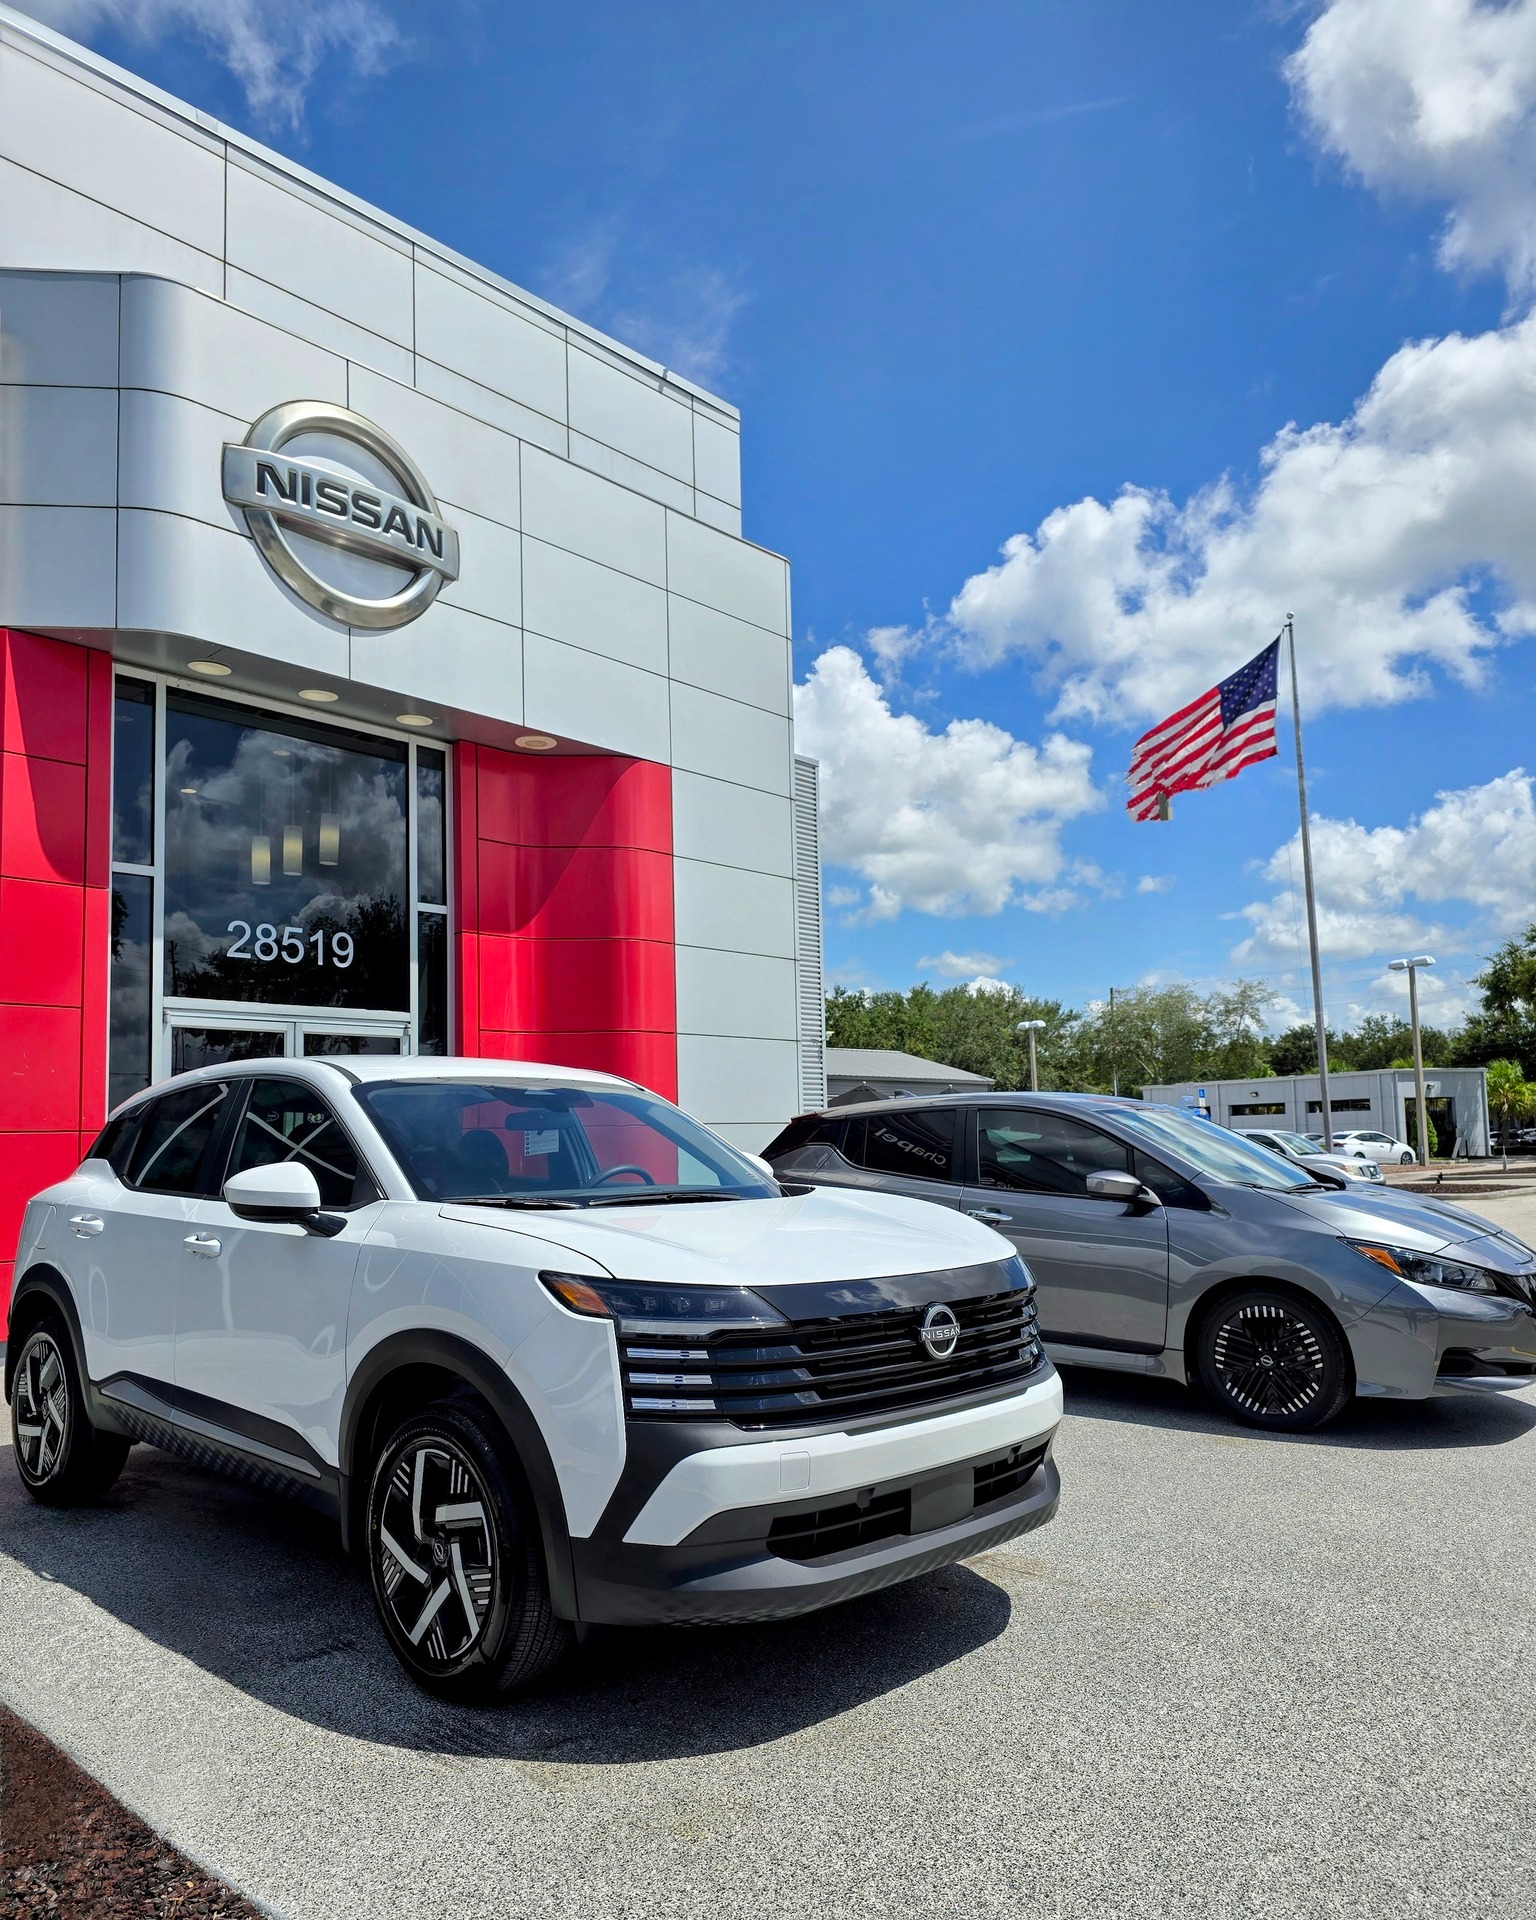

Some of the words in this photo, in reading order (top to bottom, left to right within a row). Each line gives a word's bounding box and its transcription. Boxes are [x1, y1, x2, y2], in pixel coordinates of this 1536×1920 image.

[255, 460, 444, 561] NISSAN
[226, 920, 354, 969] 28519
[922, 1327, 960, 1339] NISSAN
